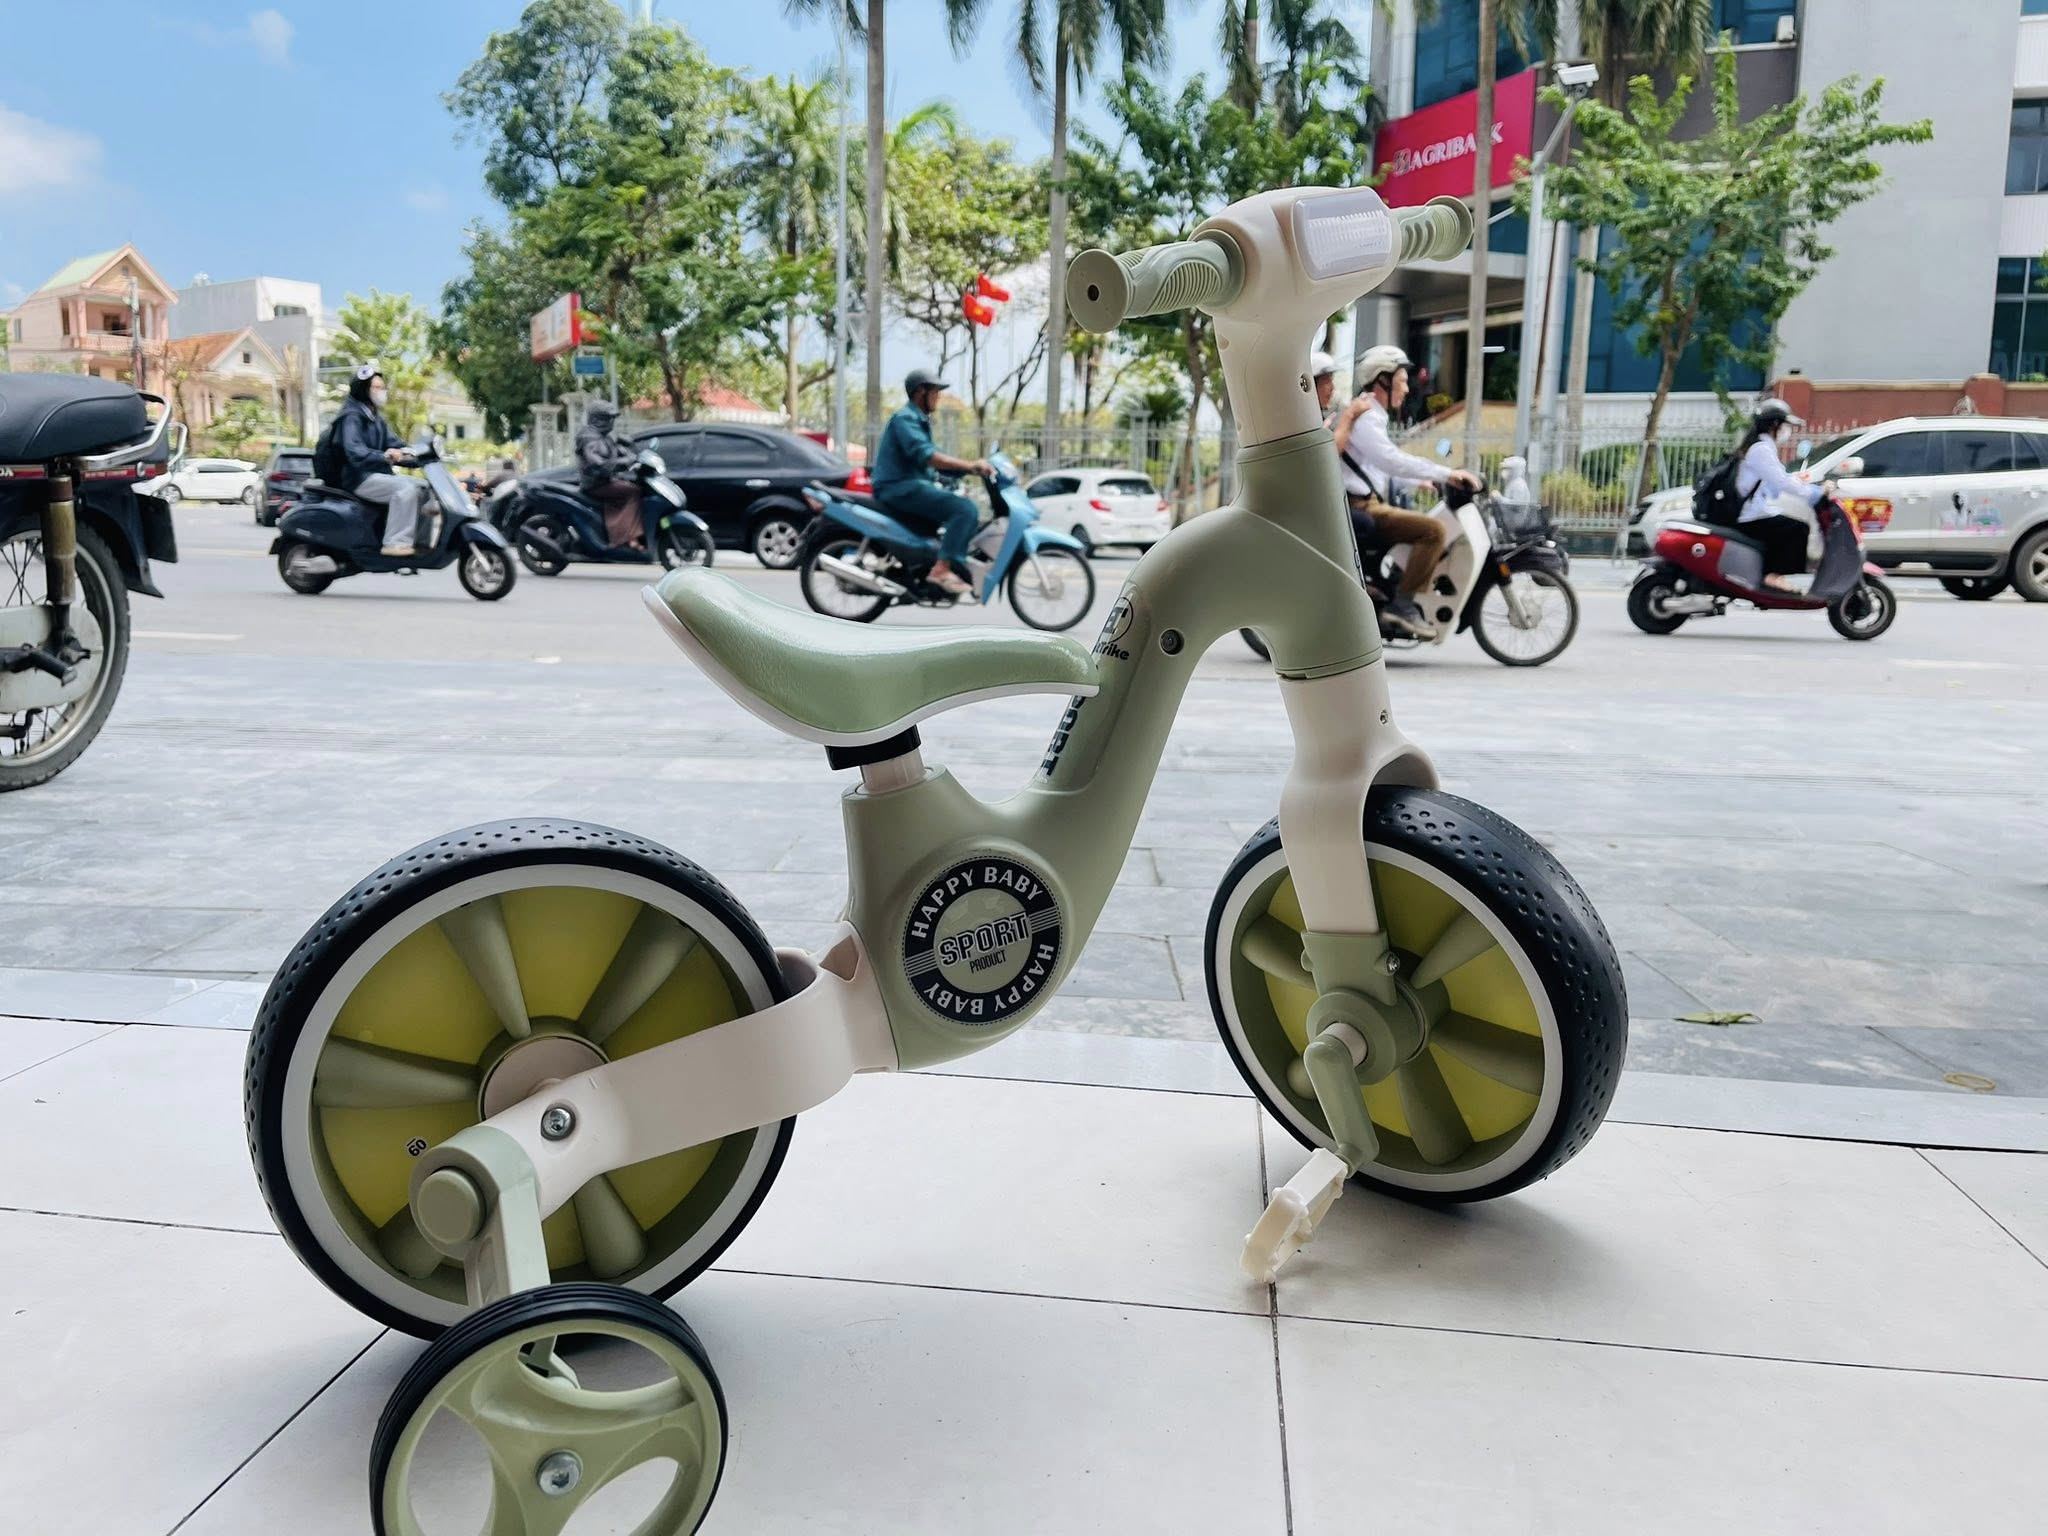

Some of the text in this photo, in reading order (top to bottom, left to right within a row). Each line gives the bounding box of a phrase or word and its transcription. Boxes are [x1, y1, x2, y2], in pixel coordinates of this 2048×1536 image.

[1410, 121, 1504, 171] AGRIBAK
[911, 866, 1044, 939] HAPPY BABY
[937, 911, 1030, 968] SPORT
[969, 950, 1007, 975] PRODUCT
[923, 943, 1055, 1016] HAPPY BABY
